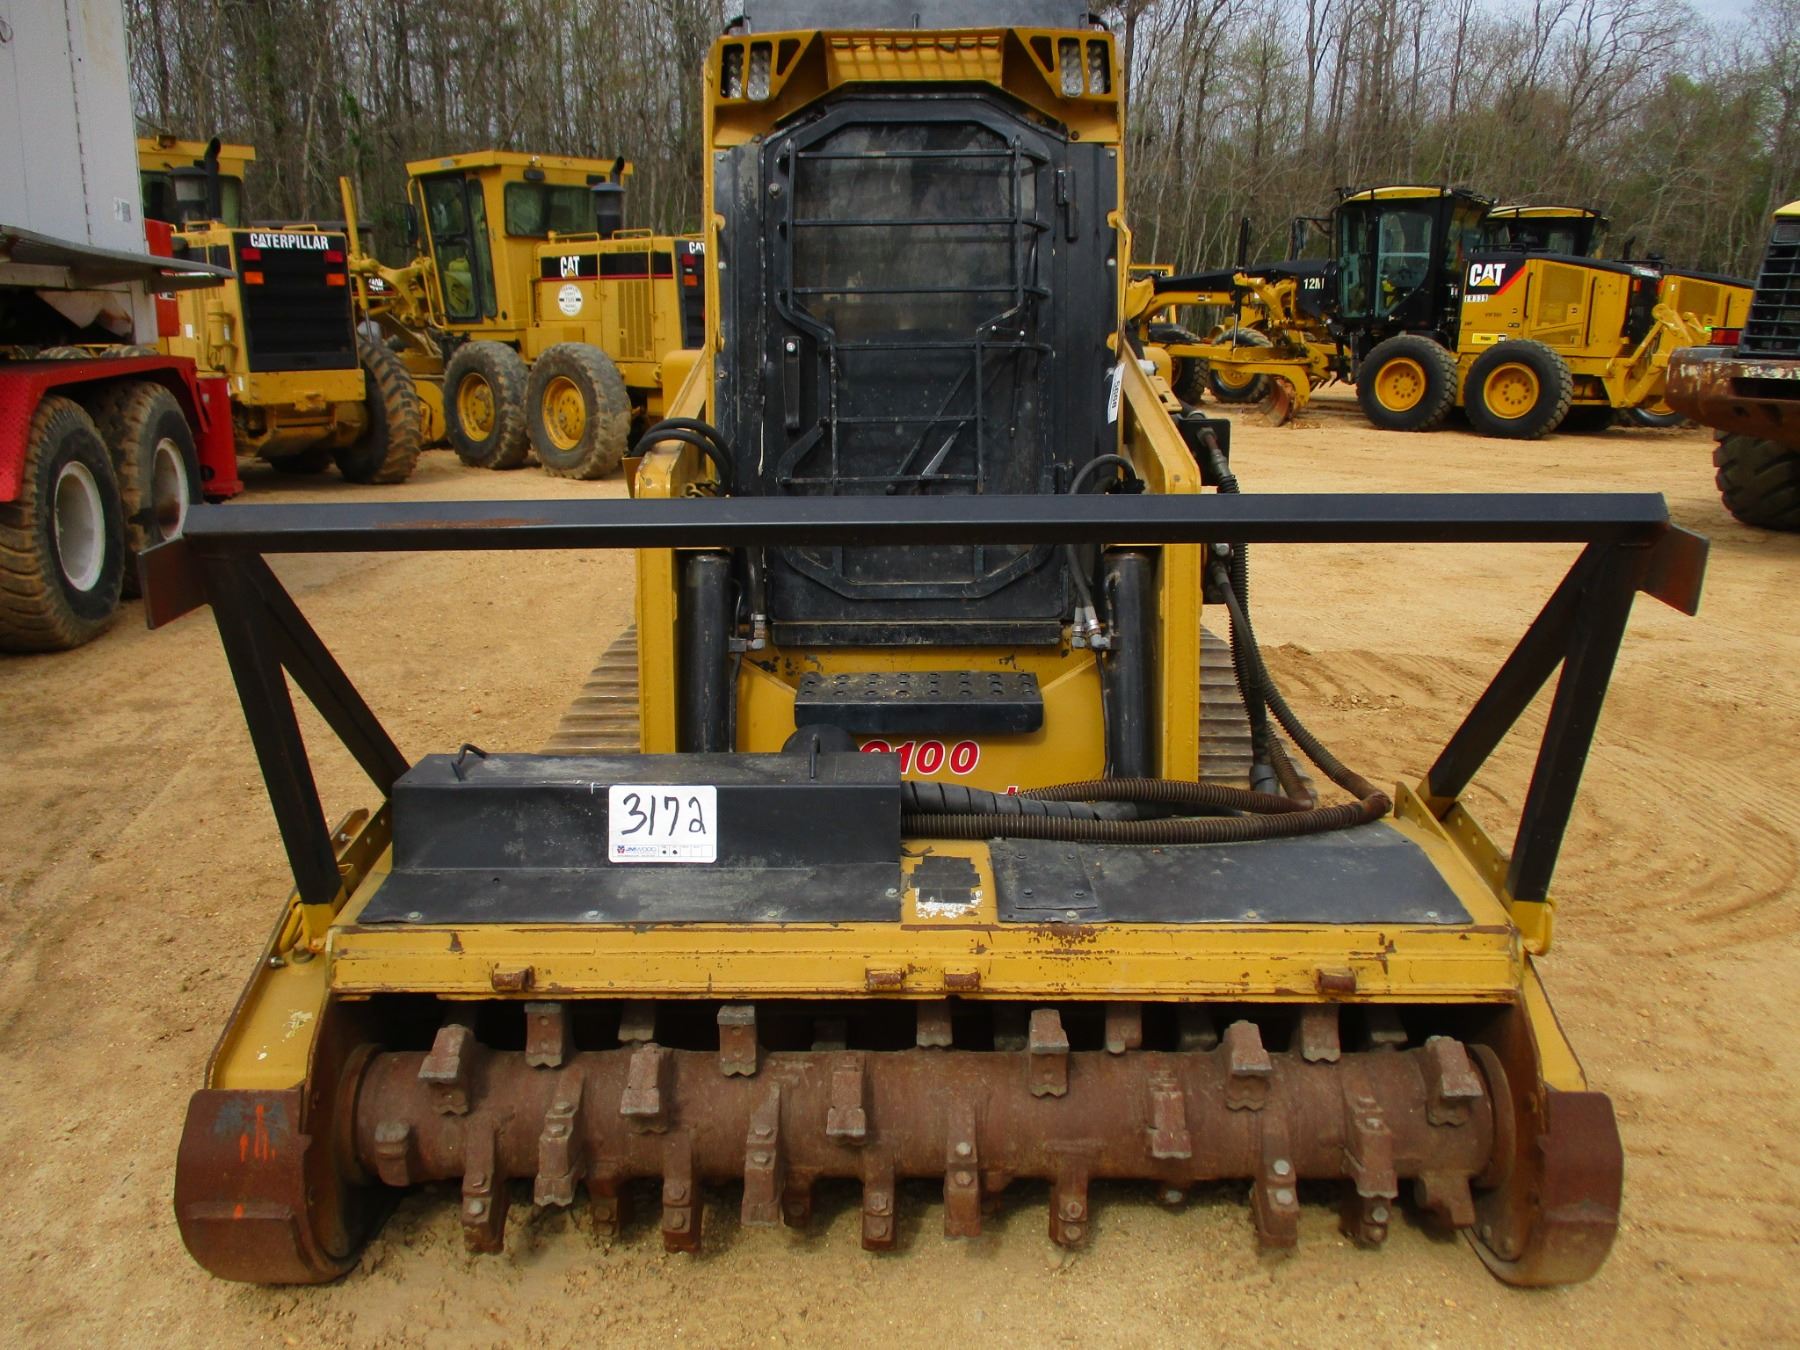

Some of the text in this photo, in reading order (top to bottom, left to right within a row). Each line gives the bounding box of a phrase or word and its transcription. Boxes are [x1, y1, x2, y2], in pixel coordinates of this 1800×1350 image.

[250, 233, 329, 250] CATERPILLAR
[560, 255, 580, 278] CAT
[1469, 263, 1506, 287] CAT
[621, 793, 706, 836] 3172
